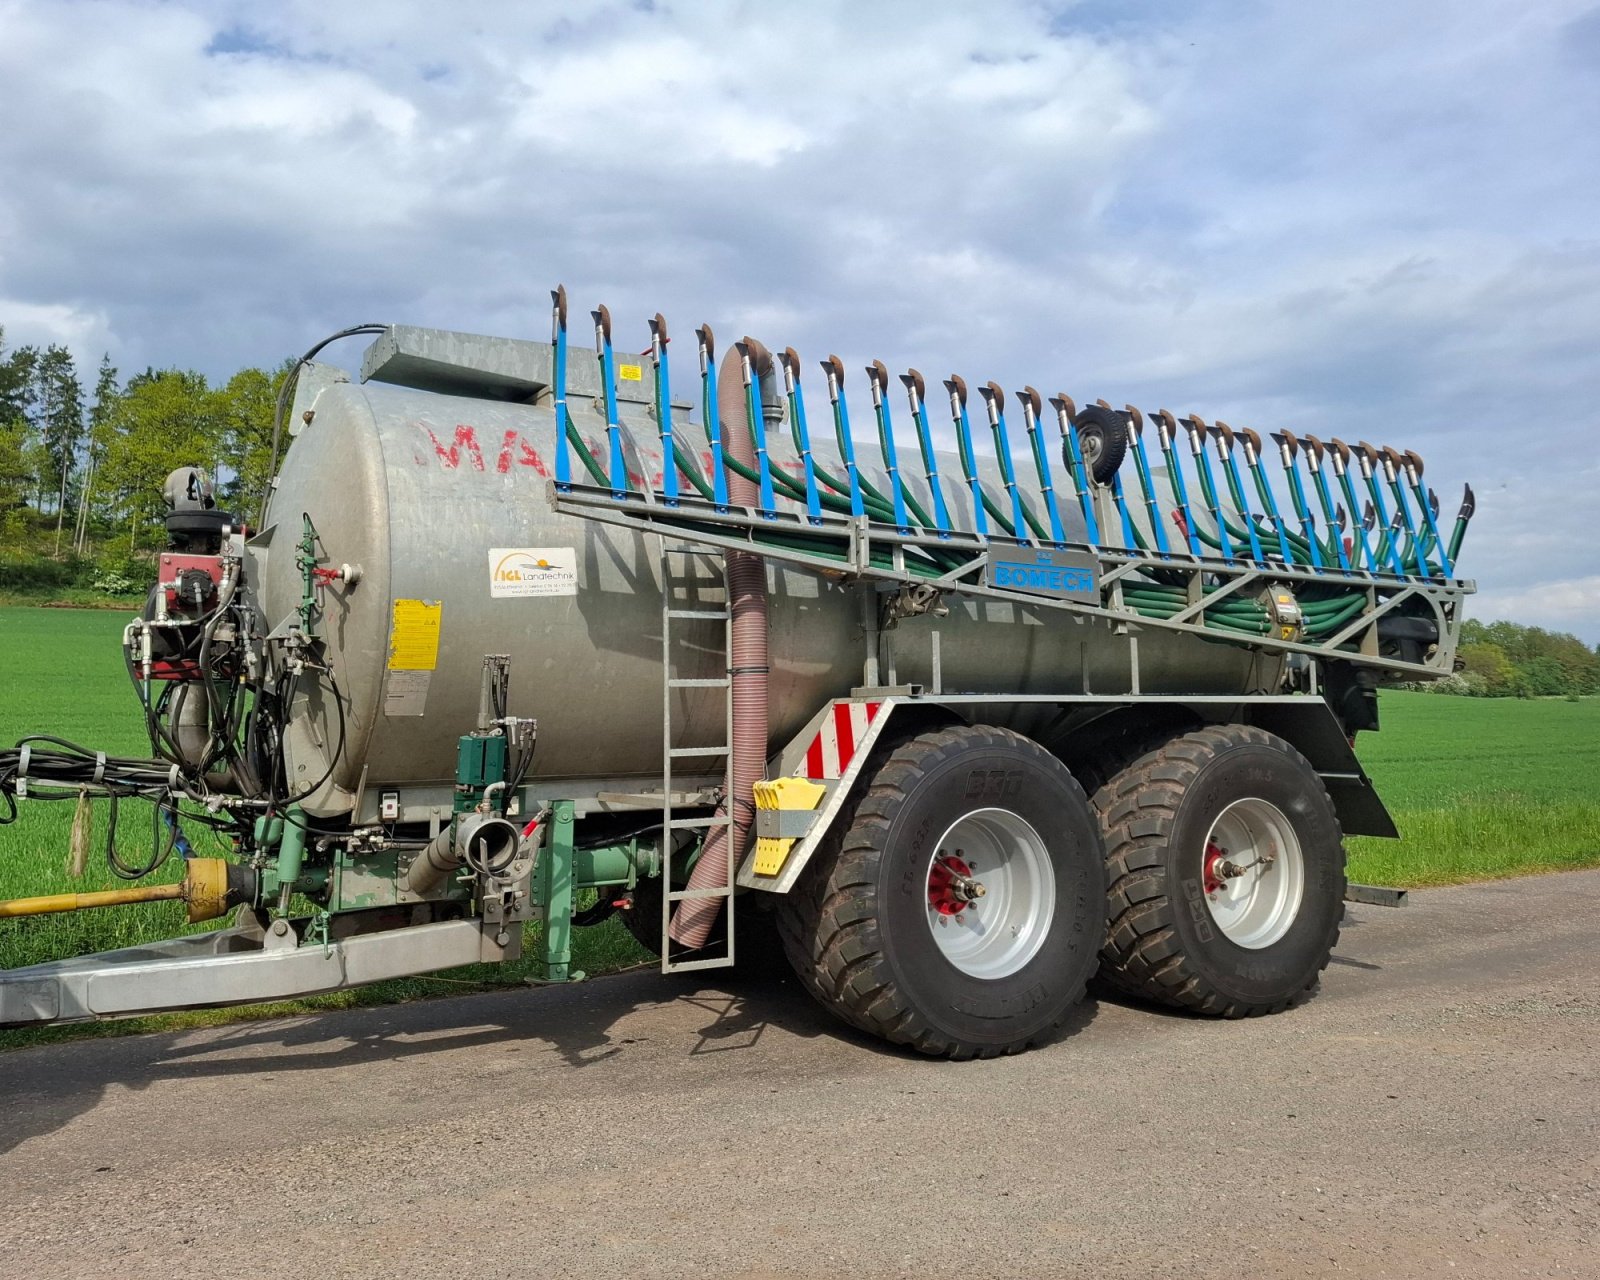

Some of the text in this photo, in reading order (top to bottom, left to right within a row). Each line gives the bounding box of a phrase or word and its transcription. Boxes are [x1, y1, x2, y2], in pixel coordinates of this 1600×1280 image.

[501, 570, 574, 581] IGL Landtechnik
[995, 567, 1094, 593] BOMECH
